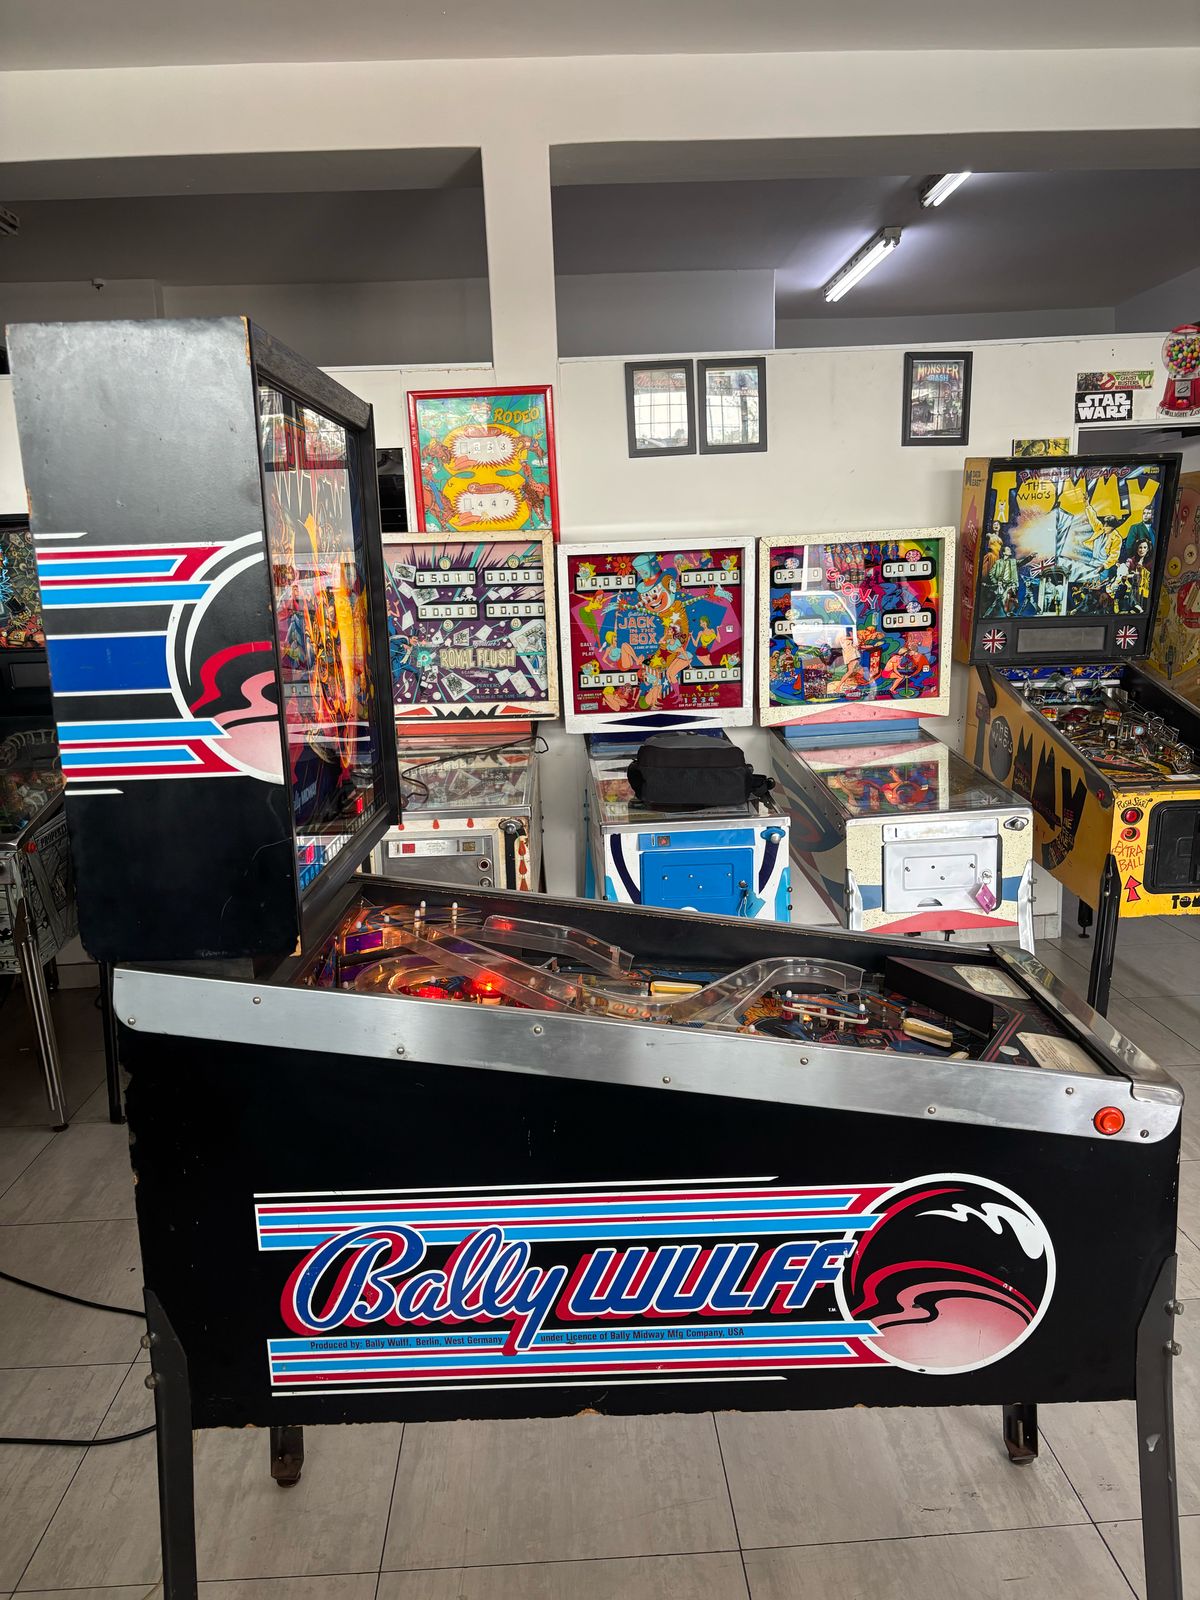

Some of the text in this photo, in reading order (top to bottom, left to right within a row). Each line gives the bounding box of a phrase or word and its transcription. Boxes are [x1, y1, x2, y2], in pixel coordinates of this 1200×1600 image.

[917, 363, 959, 380] MONSTER
[1078, 393, 1130, 407] STAR
[493, 407, 541, 424] RODEO
[1078, 405, 1131, 420] WARS
[1073, 466, 1131, 481] WIZARD
[1025, 481, 1047, 492] THE
[1017, 490, 1051, 501] WHO'S
[825, 566, 880, 610] GROOVY
[618, 616, 657, 629] JACK
[629, 633, 658, 645] BOX
[440, 648, 516, 669] ROYAL FLUSH
[995, 720, 1009, 738] THE
[1116, 797, 1152, 811] PUSH START
[1112, 840, 1144, 858] EXTRA
[1118, 857, 1144, 873] BALL
[287, 1224, 569, 1352] Bally
[563, 1239, 857, 1318] WULFF
[310, 1340, 348, 1350] Produced
[350, 1340, 363, 1350] by:
[365, 1338, 385, 1349] Bally
[415, 1337, 442, 1347] Berlin,
[444, 1336, 465, 1345] West
[467, 1336, 503, 1346] Germany
[540, 1333, 563, 1342] under
[566, 1332, 597, 1342] Licence
[599, 1332, 608, 1340] of
[610, 1331, 630, 1341] Bally
[633, 1330, 665, 1340] Midway
[667, 1329, 683, 1339] Mfg
[686, 1328, 725, 1338] Company,
[727, 1327, 745, 1337] USA
